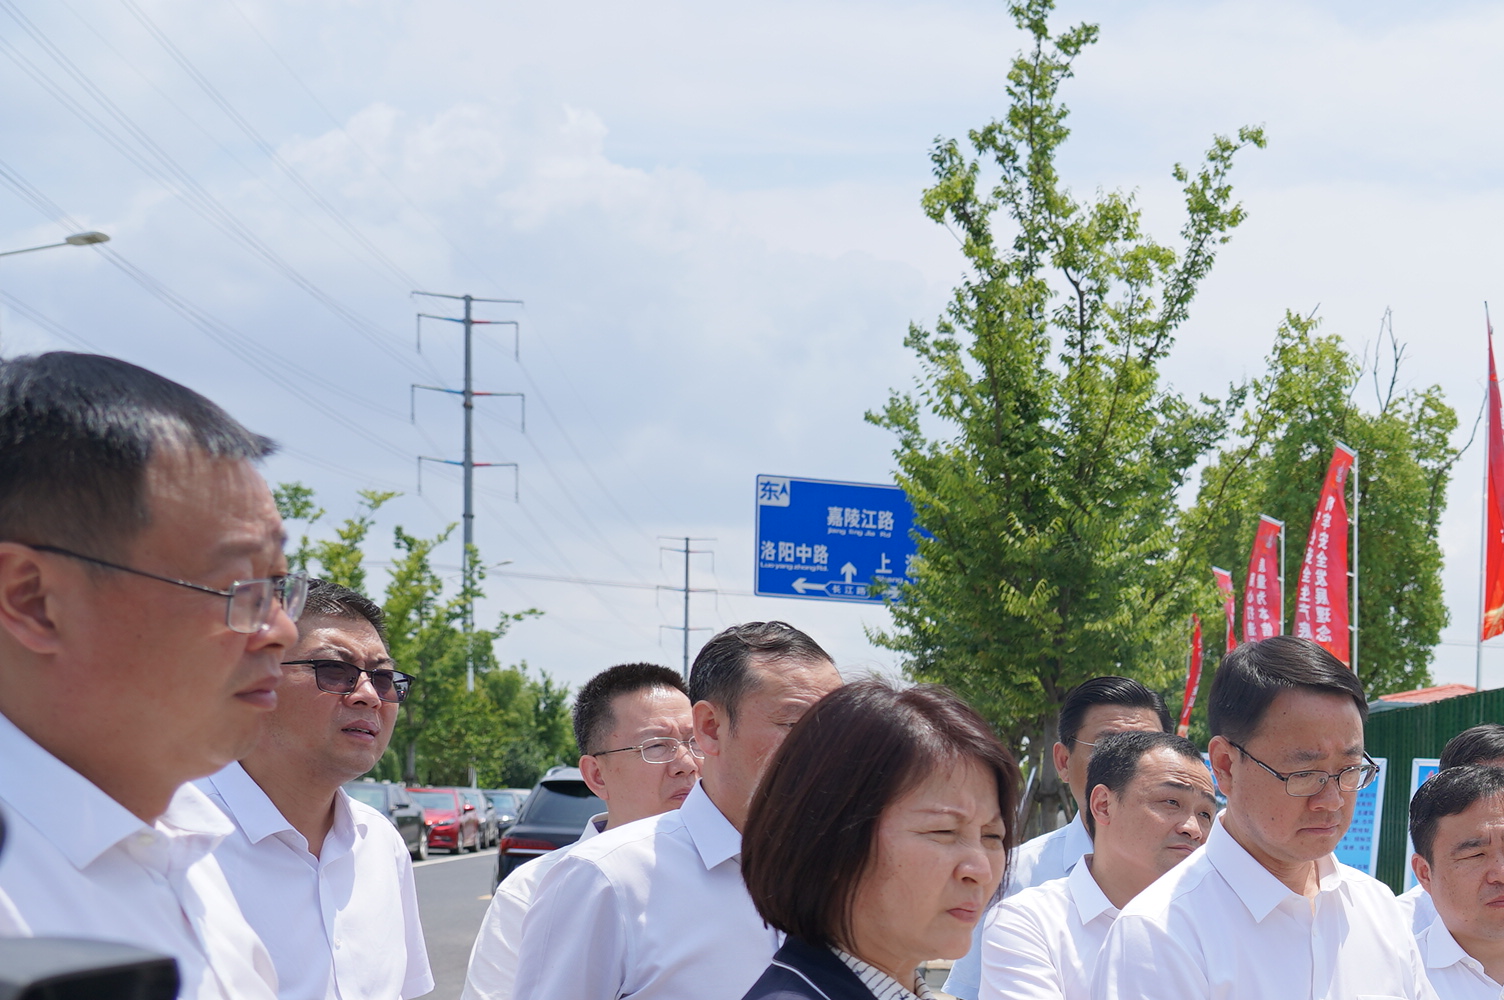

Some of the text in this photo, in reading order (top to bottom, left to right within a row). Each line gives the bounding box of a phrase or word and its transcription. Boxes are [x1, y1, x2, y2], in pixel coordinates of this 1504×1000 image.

[760, 481, 780, 501] 东
[827, 506, 894, 531] 嘉陵江路
[761, 540, 829, 564] 洛阳中路
